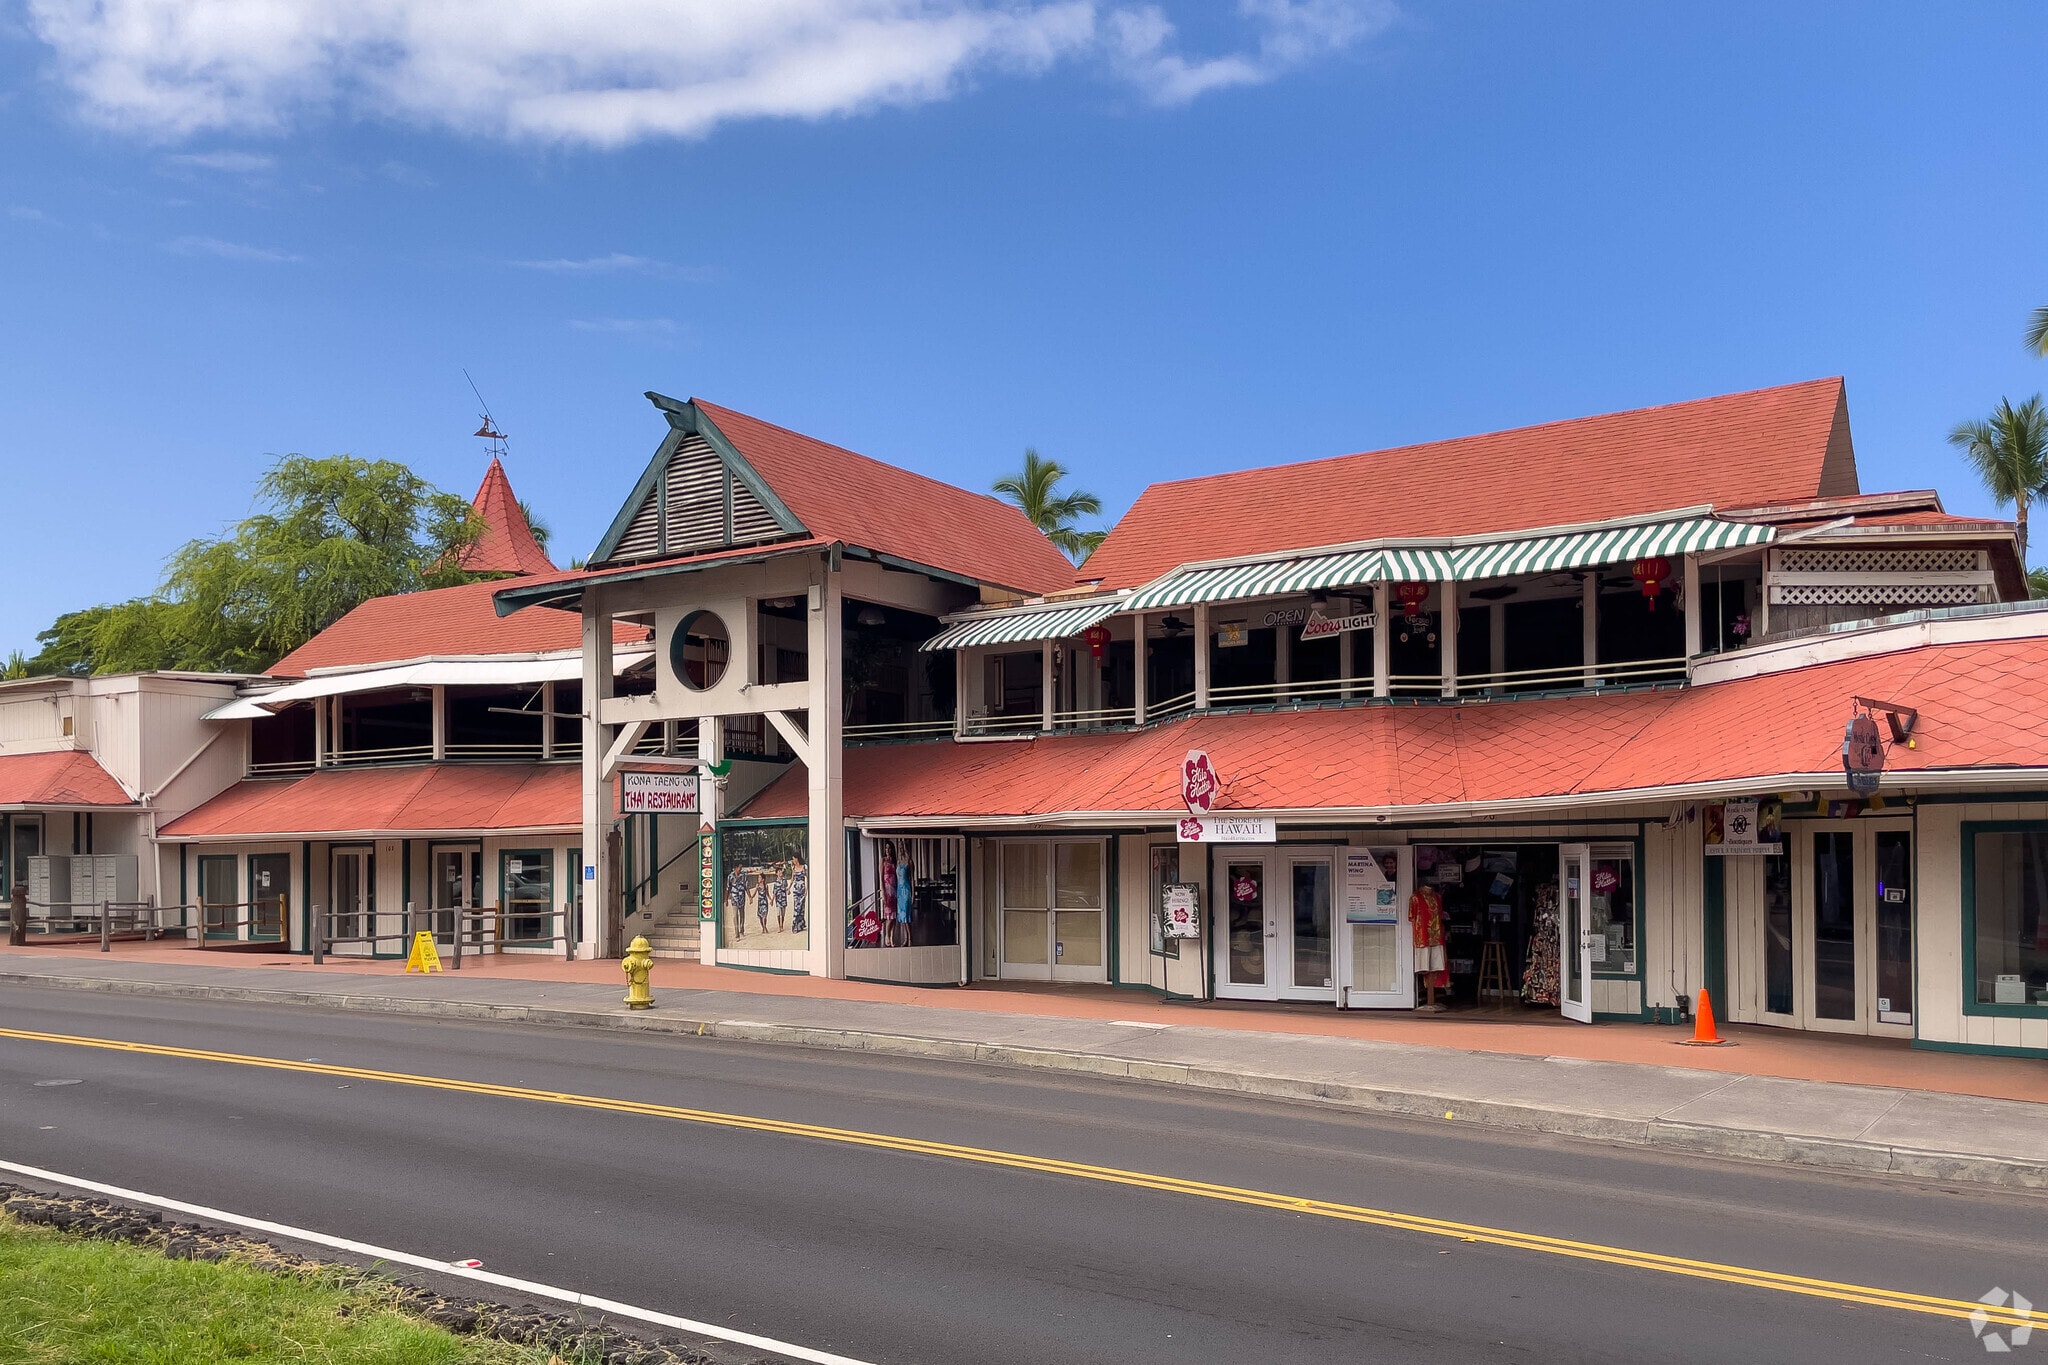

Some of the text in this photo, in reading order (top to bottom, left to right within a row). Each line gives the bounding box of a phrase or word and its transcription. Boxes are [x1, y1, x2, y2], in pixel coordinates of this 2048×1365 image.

[1263, 608, 1306, 626] OPEN
[1304, 613, 1378, 636] Coors LIGHT
[627, 775, 651, 786] KONA
[1191, 767, 1207, 783] Hilo
[1190, 780, 1212, 798] Hattie
[625, 790, 696, 809] THAI RESTAURANT
[1595, 872, 1612, 882] Hilo
[858, 924, 880, 937] Hattie
[859, 918, 876, 929] Hilo
